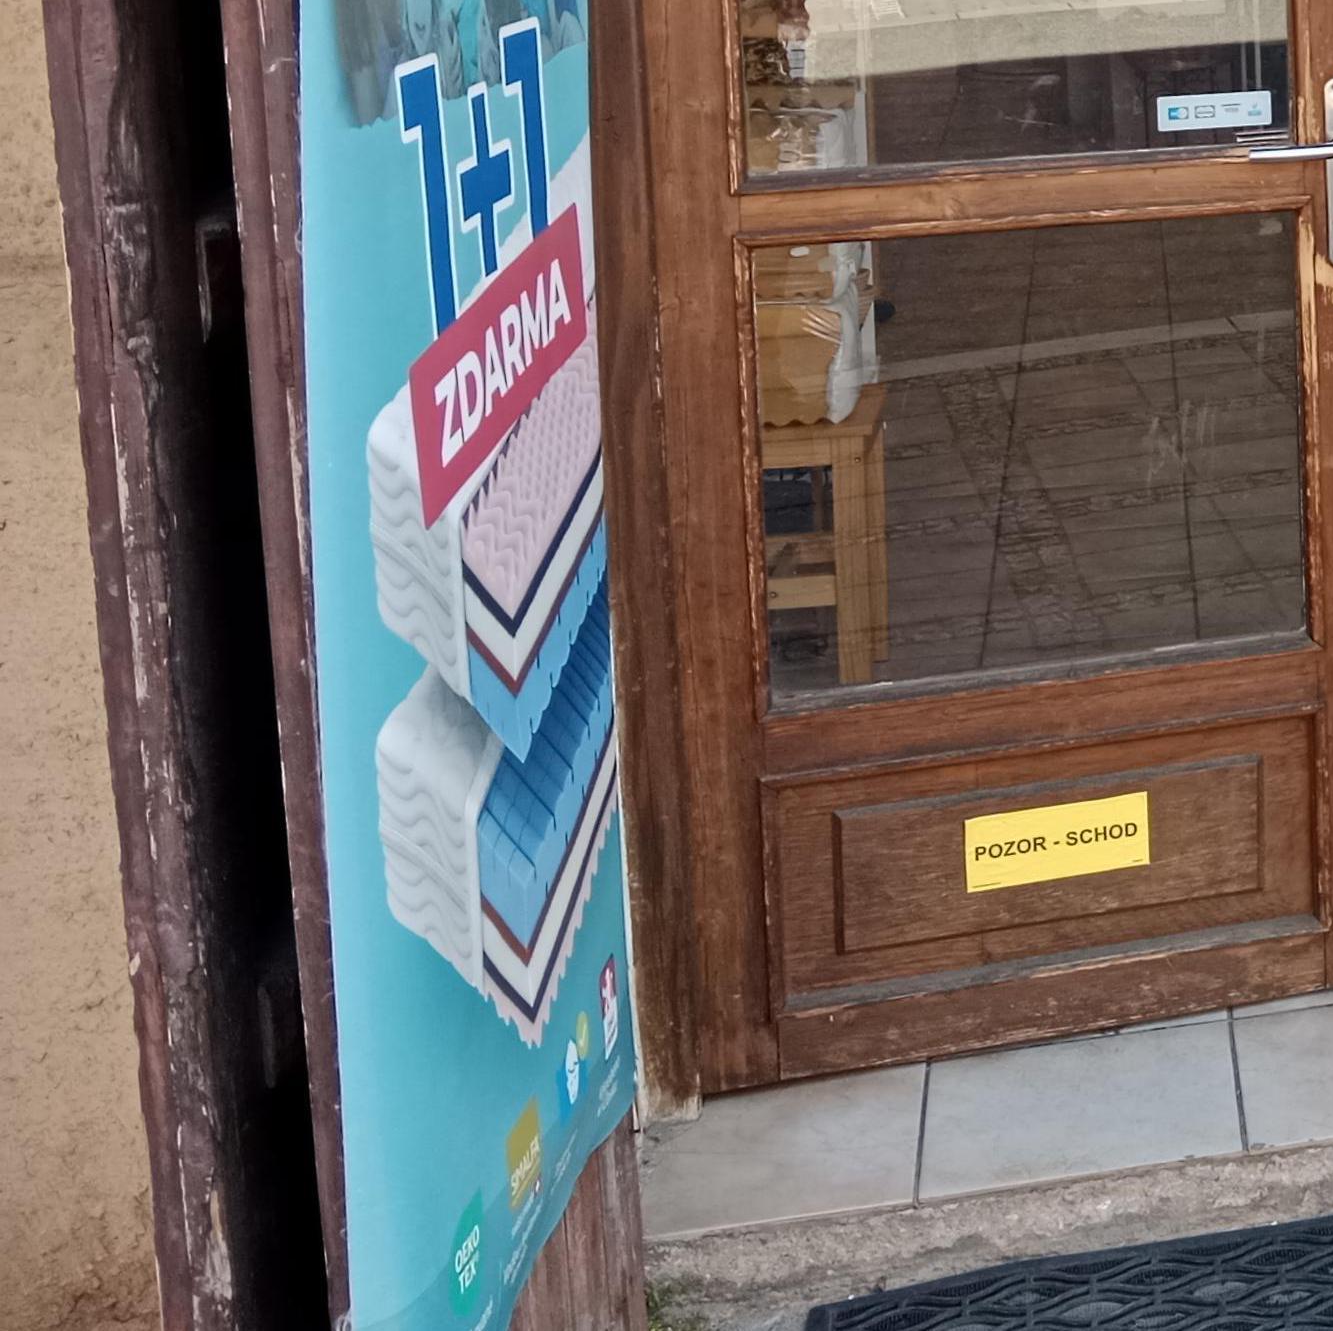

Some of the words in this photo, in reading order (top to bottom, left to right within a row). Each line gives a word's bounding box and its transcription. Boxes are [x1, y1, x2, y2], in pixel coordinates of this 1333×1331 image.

[394, 16, 550, 341] 1+1
[433, 258, 573, 469] ZDARMA
[974, 835, 1048, 862] POZOR
[1066, 821, 1139, 847] SCHOD
[454, 1224, 480, 1274] OEKO
